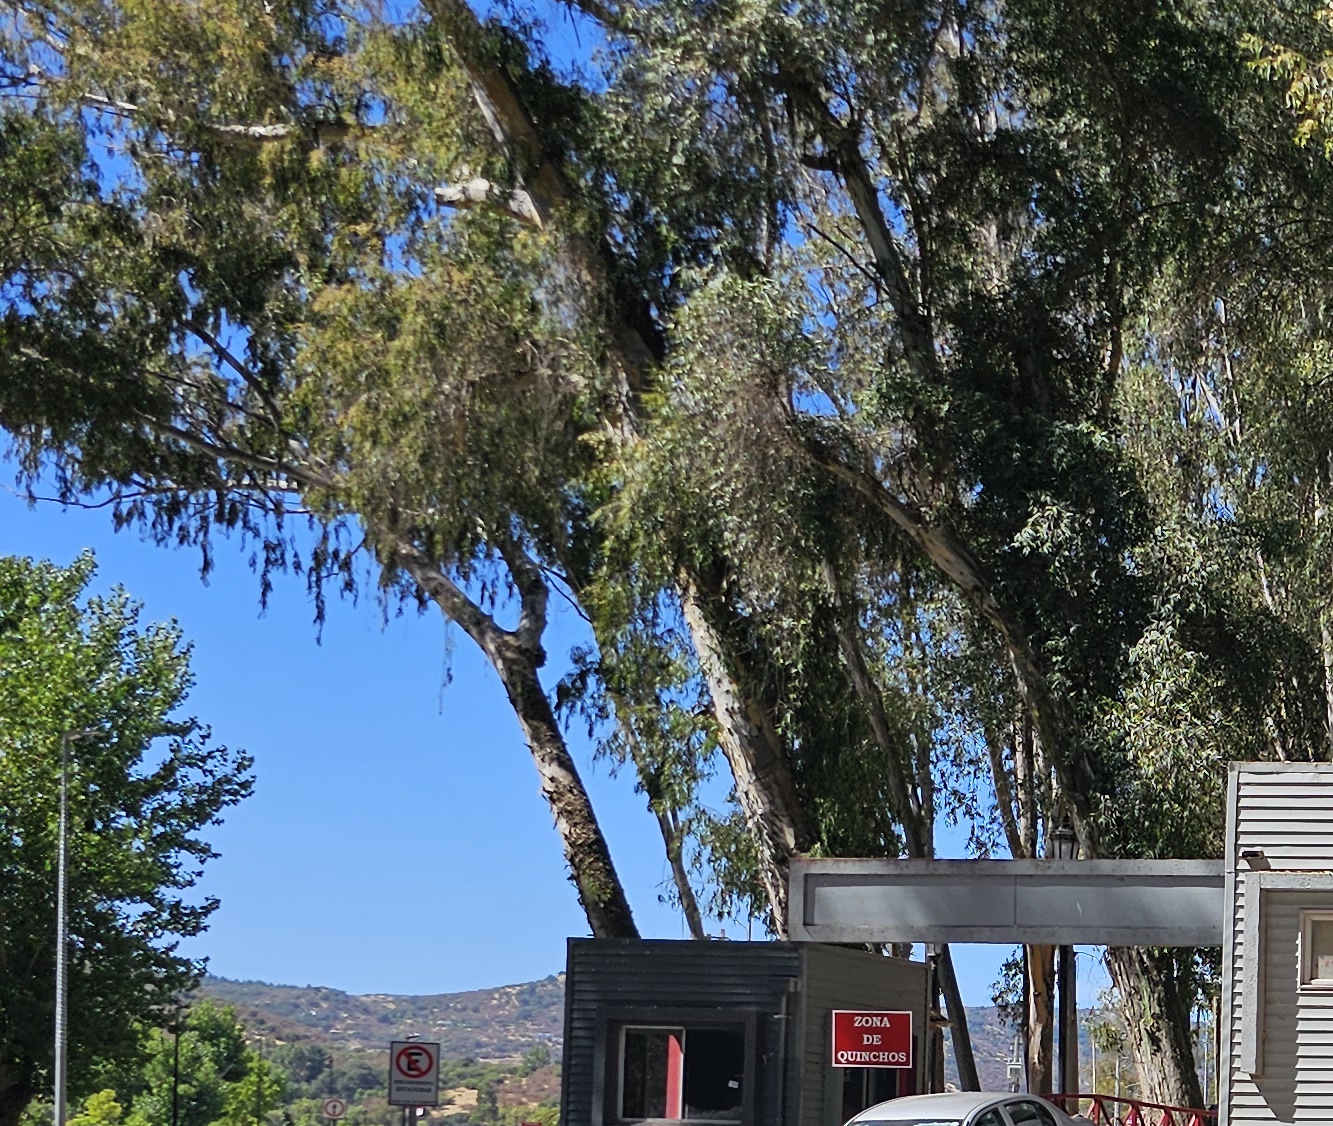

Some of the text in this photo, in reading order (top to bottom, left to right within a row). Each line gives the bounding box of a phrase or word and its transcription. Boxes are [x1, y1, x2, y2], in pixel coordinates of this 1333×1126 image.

[853, 1016, 891, 1028] ZONA
[862, 1034, 882, 1045] DE
[837, 1050, 907, 1064] QUINCHOS
